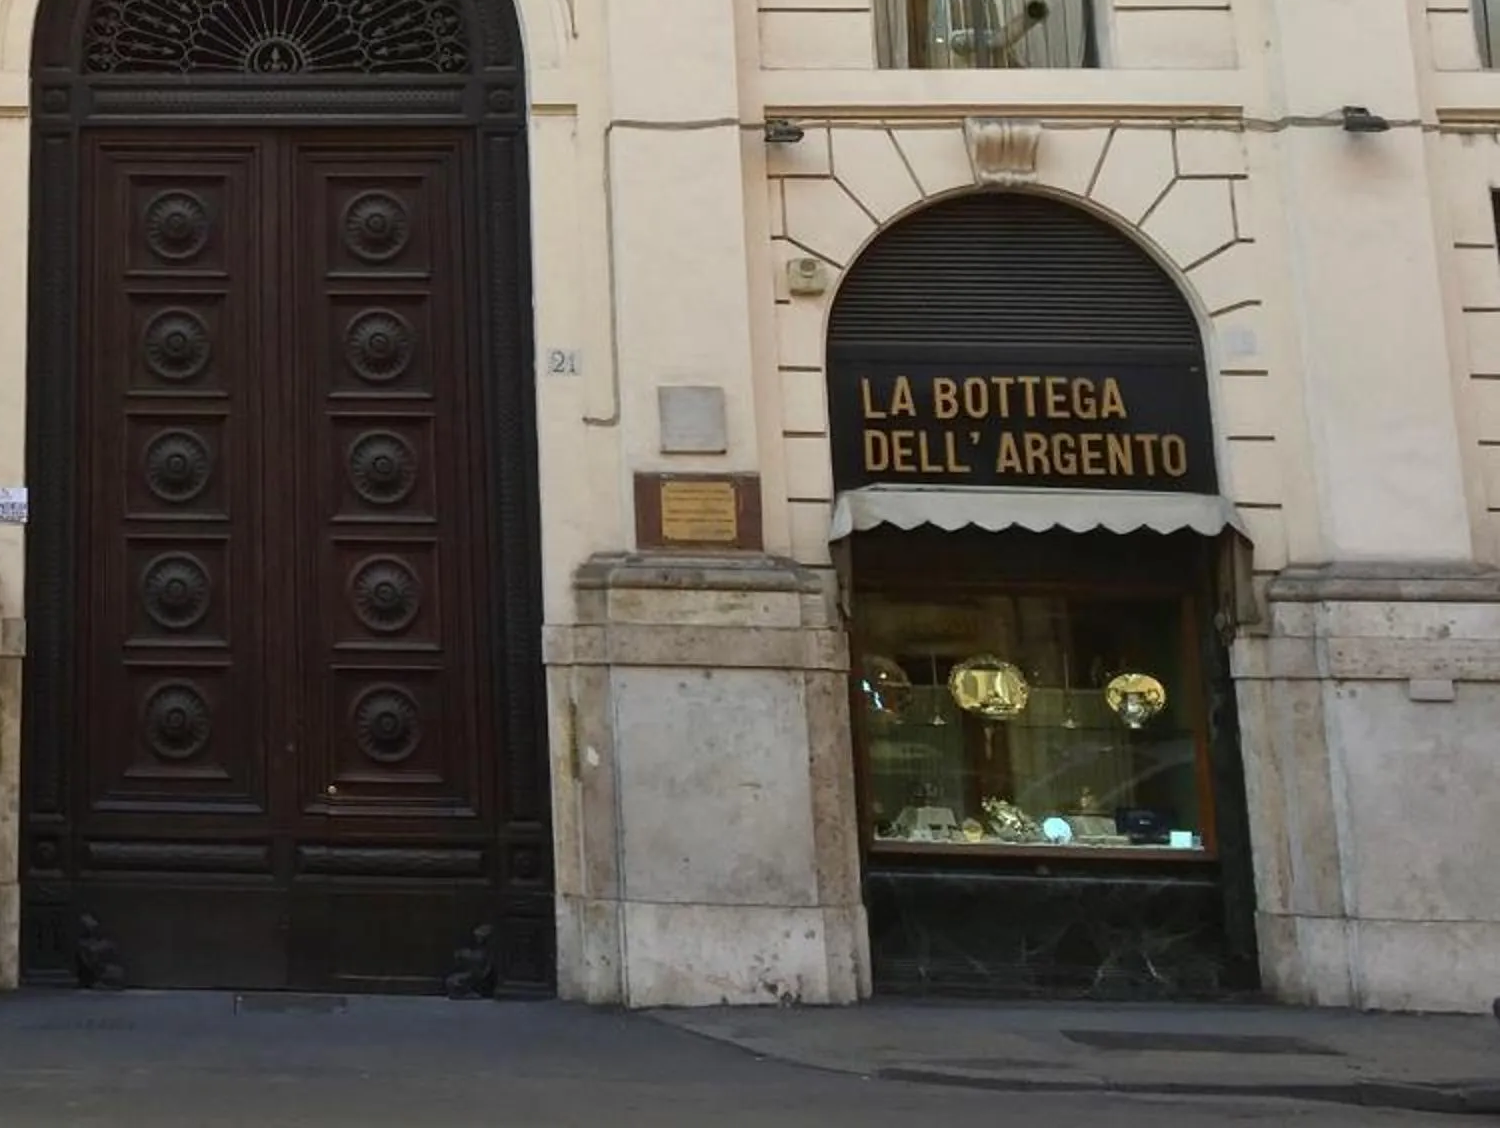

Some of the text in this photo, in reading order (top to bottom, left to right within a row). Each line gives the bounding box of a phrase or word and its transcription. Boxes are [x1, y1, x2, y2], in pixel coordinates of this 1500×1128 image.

[551, 350, 576, 373] 21
[861, 375, 1127, 419] LA BOTTEGA
[864, 429, 1188, 477] DELL' ARGENTO
